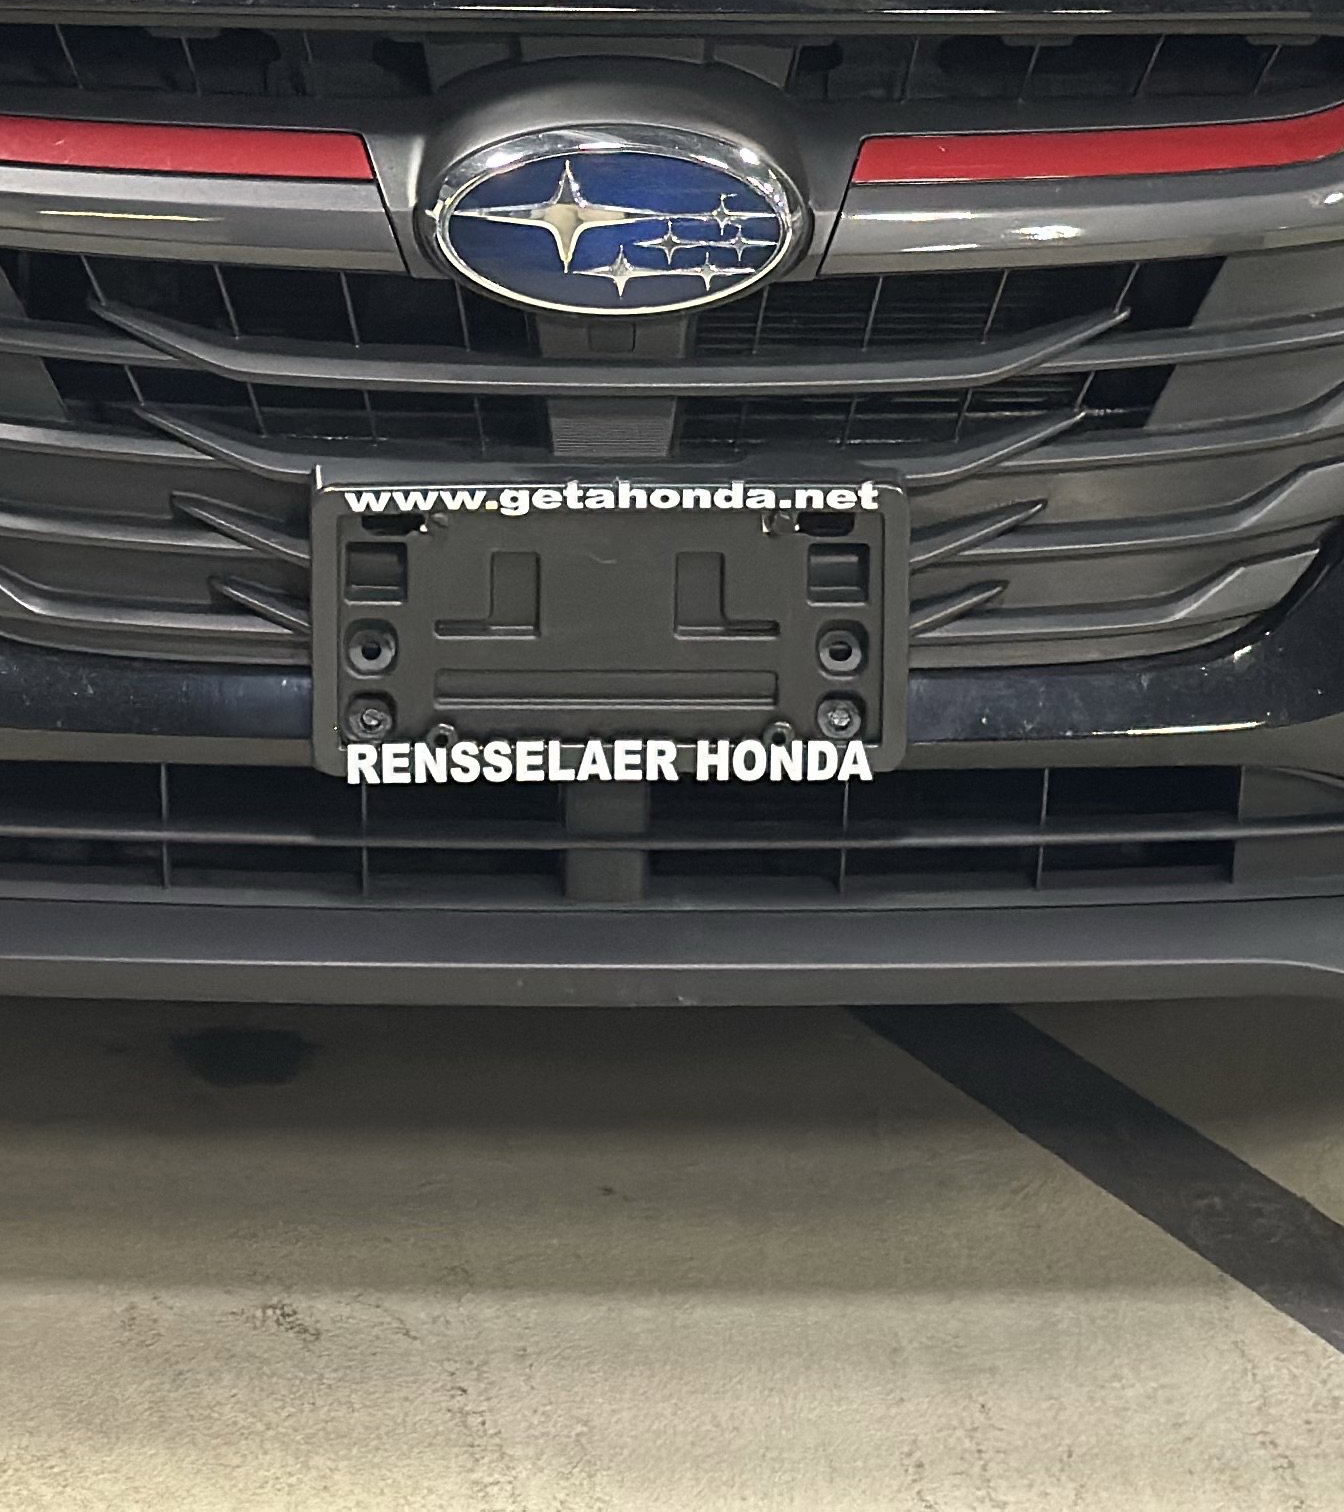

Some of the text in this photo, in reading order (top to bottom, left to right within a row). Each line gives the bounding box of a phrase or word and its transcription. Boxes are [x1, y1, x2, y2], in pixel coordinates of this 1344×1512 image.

[344, 480, 878, 516] www.getahonda.net
[346, 740, 873, 784] RENSSELAER HONDA
